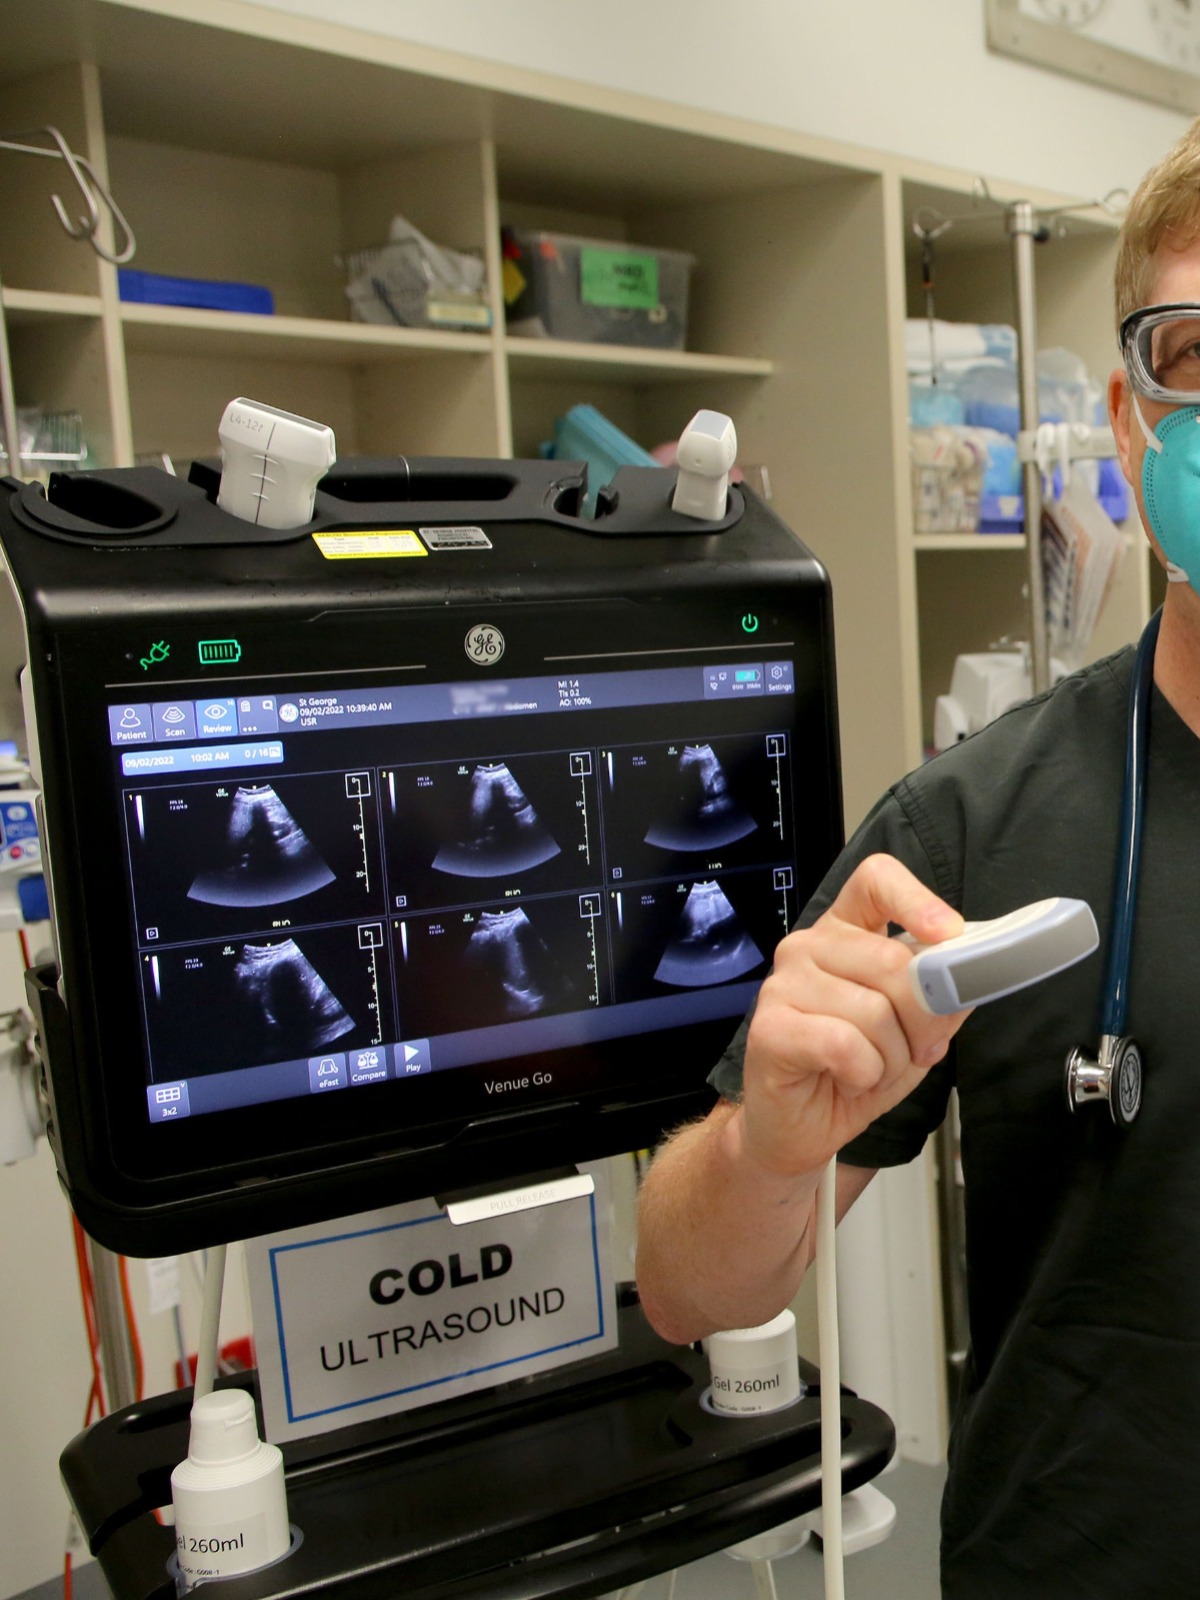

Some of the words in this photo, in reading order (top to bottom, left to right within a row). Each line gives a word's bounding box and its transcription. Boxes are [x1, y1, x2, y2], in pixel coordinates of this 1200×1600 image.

[569, 680, 579, 688] 1.4
[768, 683, 792, 692] Settings
[570, 688, 580, 697] 0.2
[299, 698, 308, 706] St
[308, 698, 338, 706] George
[574, 698, 592, 706] 100%
[300, 706, 344, 716] 09/02/2022
[379, 702, 392, 710] AM
[301, 718, 318, 726] USR
[165, 728, 186, 737] Scan
[204, 724, 232, 734] Review
[116, 730, 147, 740] Patient
[125, 756, 174, 768] 09/02/2022
[191, 754, 213, 762] 10:02
[214, 752, 230, 760] AM
[406, 1063, 422, 1073] Play
[352, 1070, 386, 1083] Compare
[320, 1078, 339, 1088] eFast
[484, 1077, 529, 1095] Venue
[532, 1072, 552, 1086] Go
[162, 1106, 178, 1116] 3x2
[490, 1200, 512, 1211] PULL
[516, 1189, 556, 1205] RELEASE
[369, 1243, 513, 1306] COLD
[320, 1287, 565, 1372] ULTRASOUND
[714, 1376, 730, 1392] Gel
[735, 1374, 780, 1393] 260ml
[190, 1532, 244, 1553] 260ml
